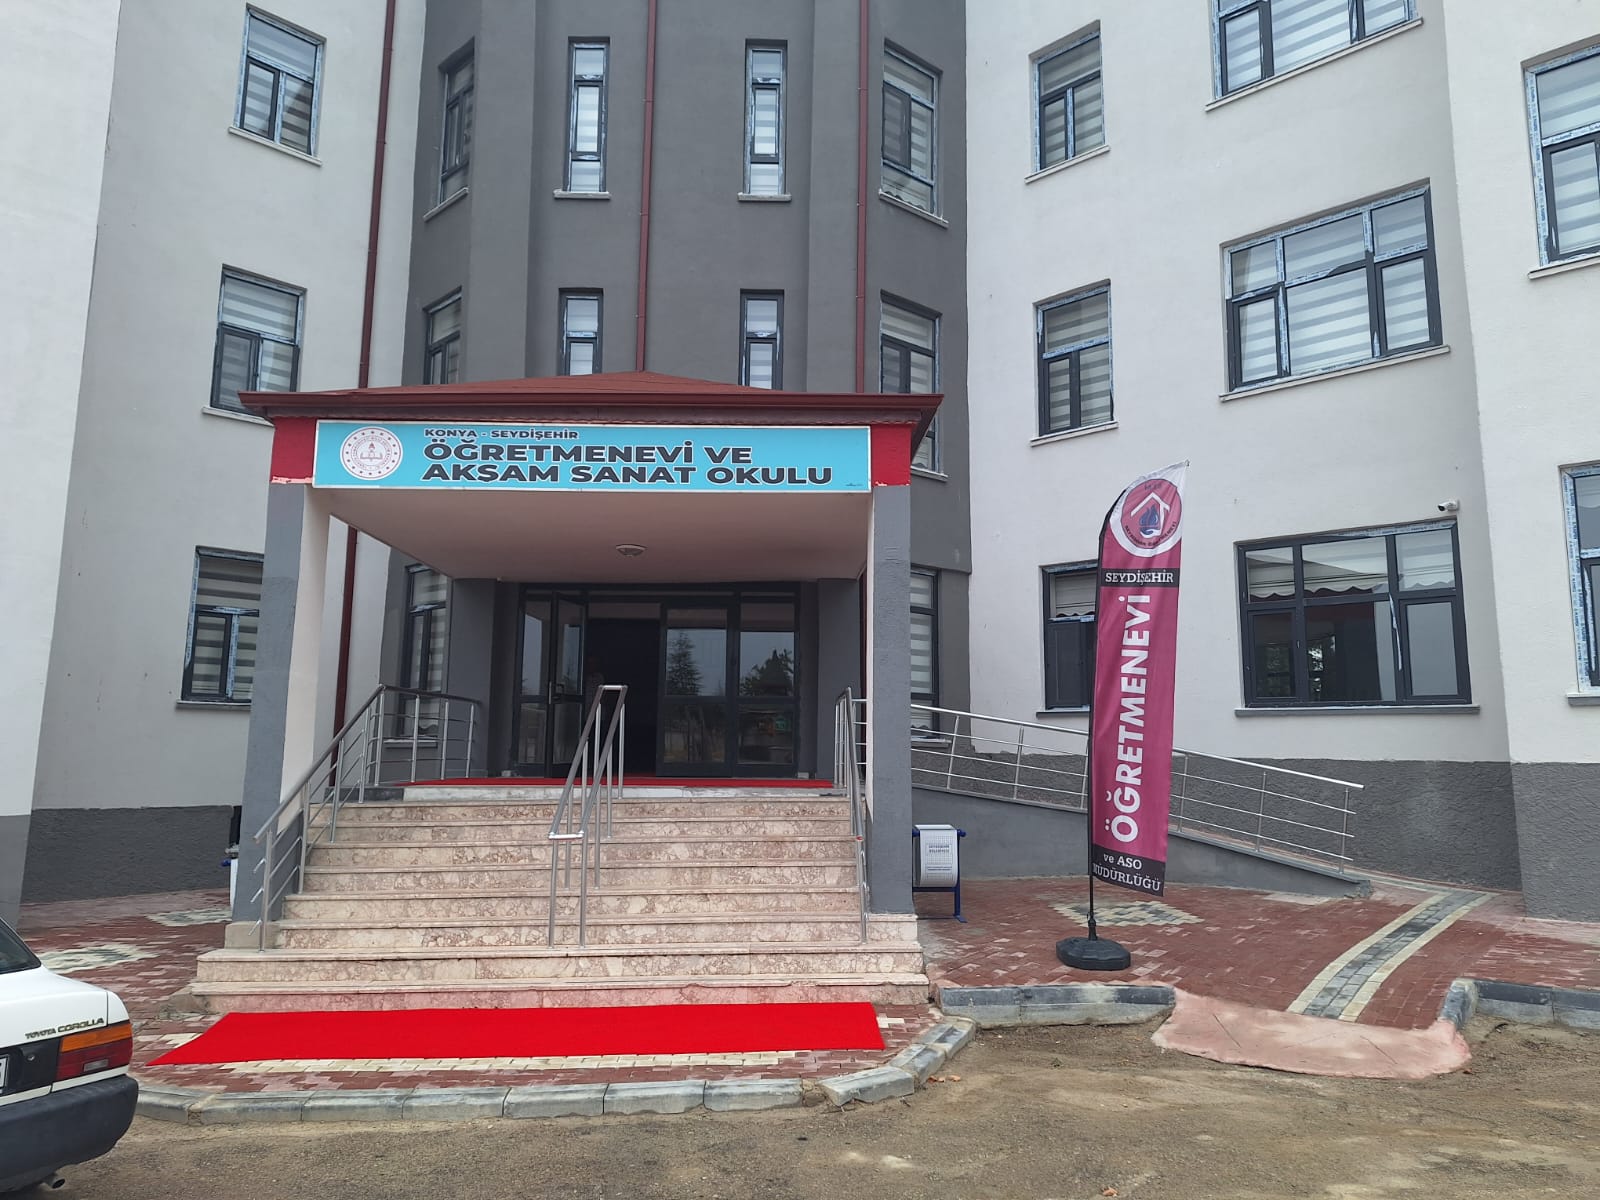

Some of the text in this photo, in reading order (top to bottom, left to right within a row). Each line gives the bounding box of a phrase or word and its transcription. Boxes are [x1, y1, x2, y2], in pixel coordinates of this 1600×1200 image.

[425, 428, 477, 438] KONYA
[491, 428, 578, 440] SEYDİŞEHİR
[424, 438, 752, 463] ÖĞRETMENEVİ VE
[422, 463, 832, 484] AKŞAM SANAT OKULU
[1105, 569, 1174, 585] SEYDİŞEHİR
[1104, 595, 1151, 842] ÖĞRETMENEVİ
[1103, 853, 1142, 870] ve ASO
[25, 1018, 104, 1039] TOYOTA COROLLA
